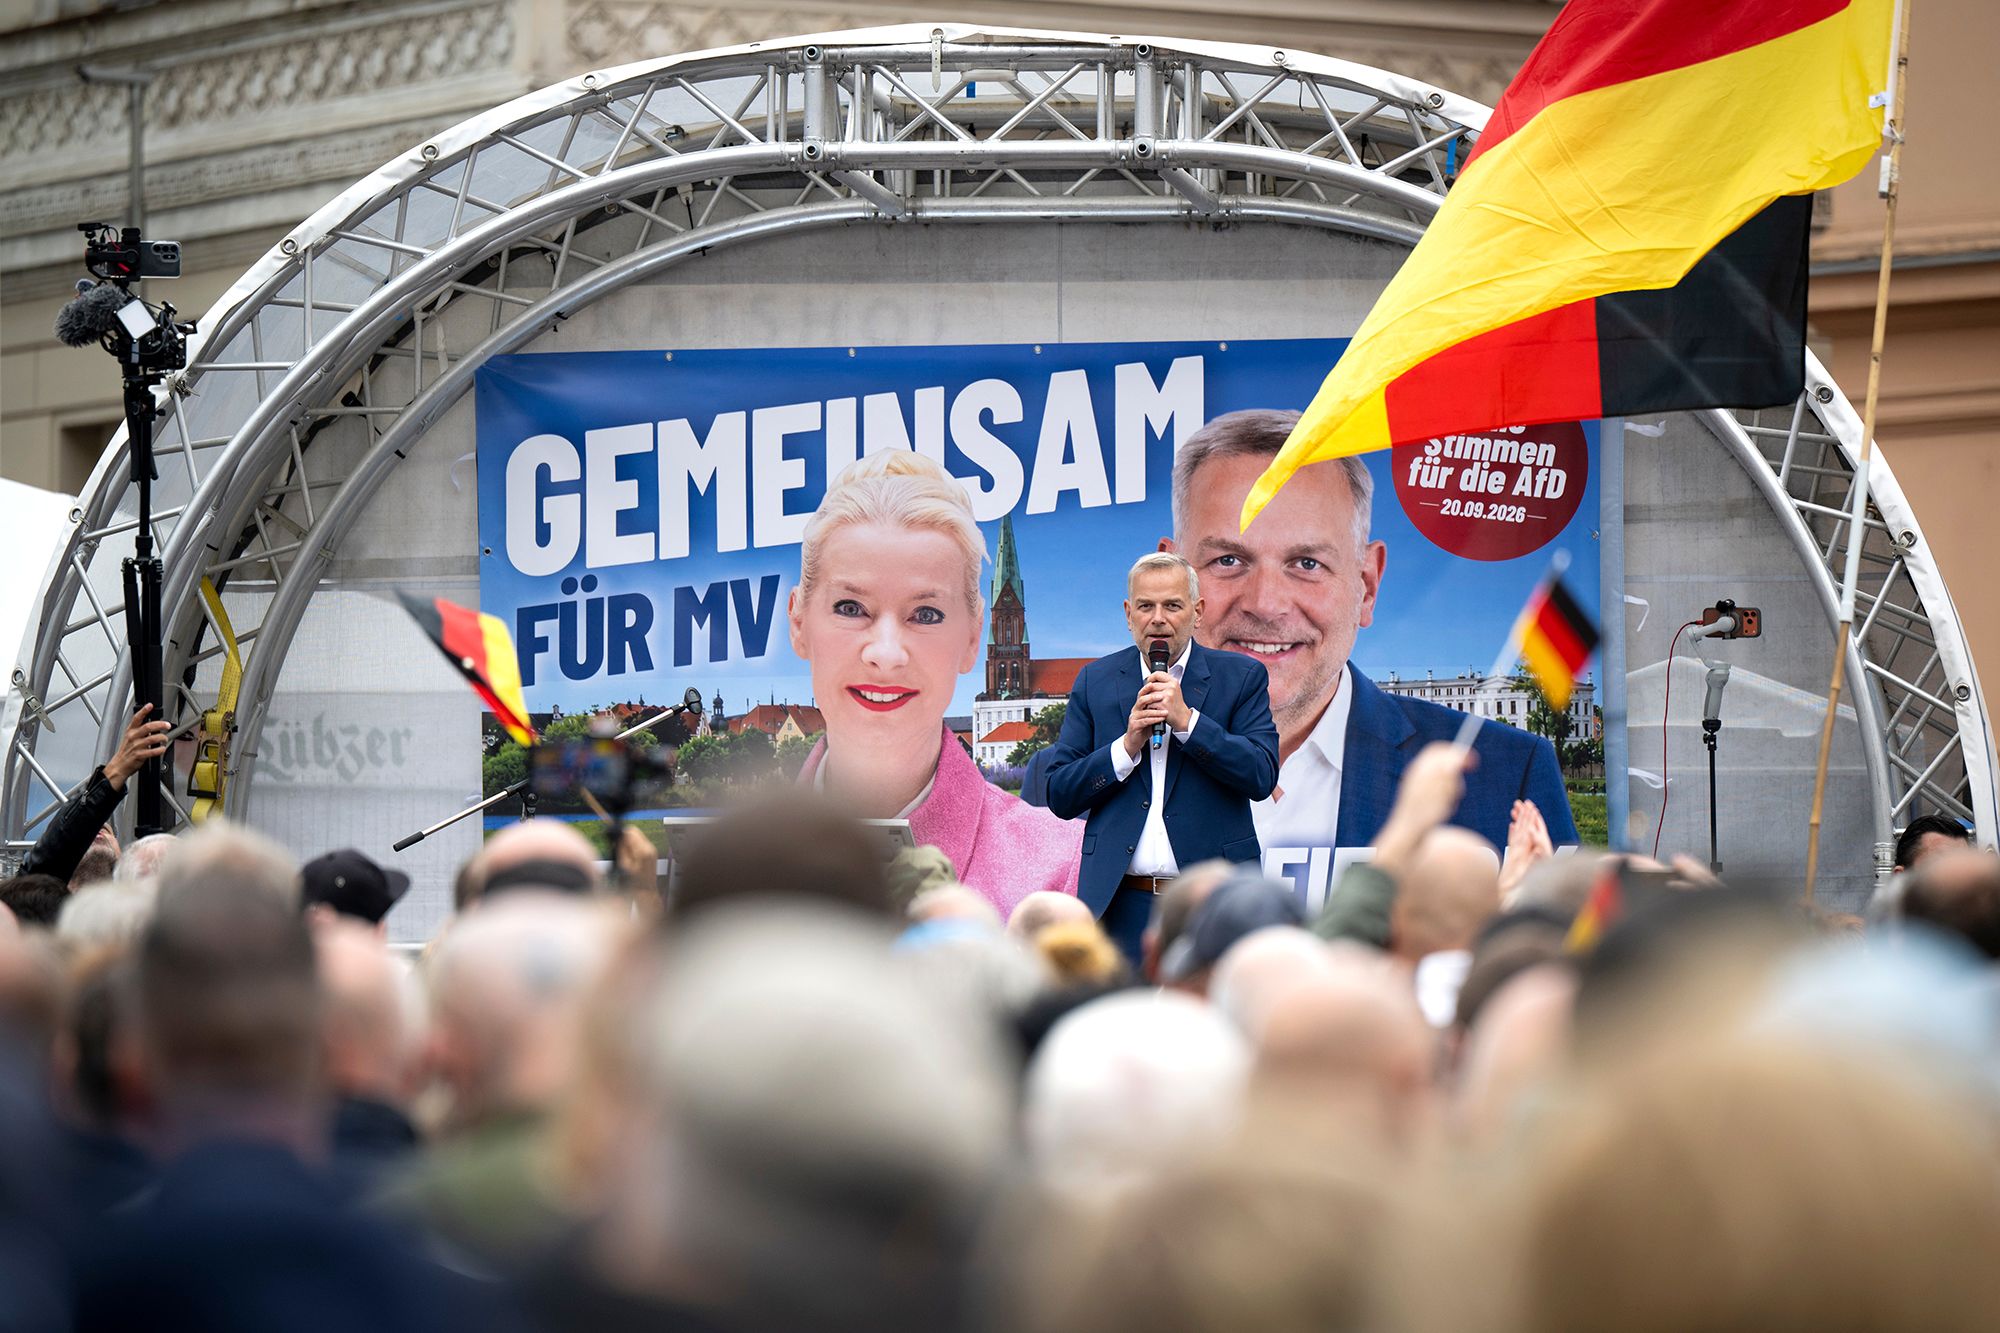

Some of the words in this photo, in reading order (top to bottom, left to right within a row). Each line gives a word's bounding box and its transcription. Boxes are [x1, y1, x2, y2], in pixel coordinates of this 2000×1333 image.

[1424, 434, 1556, 466] Stimmen
[1407, 456, 1454, 488] für
[1459, 461, 1506, 494] die
[1511, 465, 1567, 499] AfD
[1440, 498, 1526, 523] 20.09.2026
[516, 574, 654, 687] FÜR
[673, 574, 780, 667] MV
